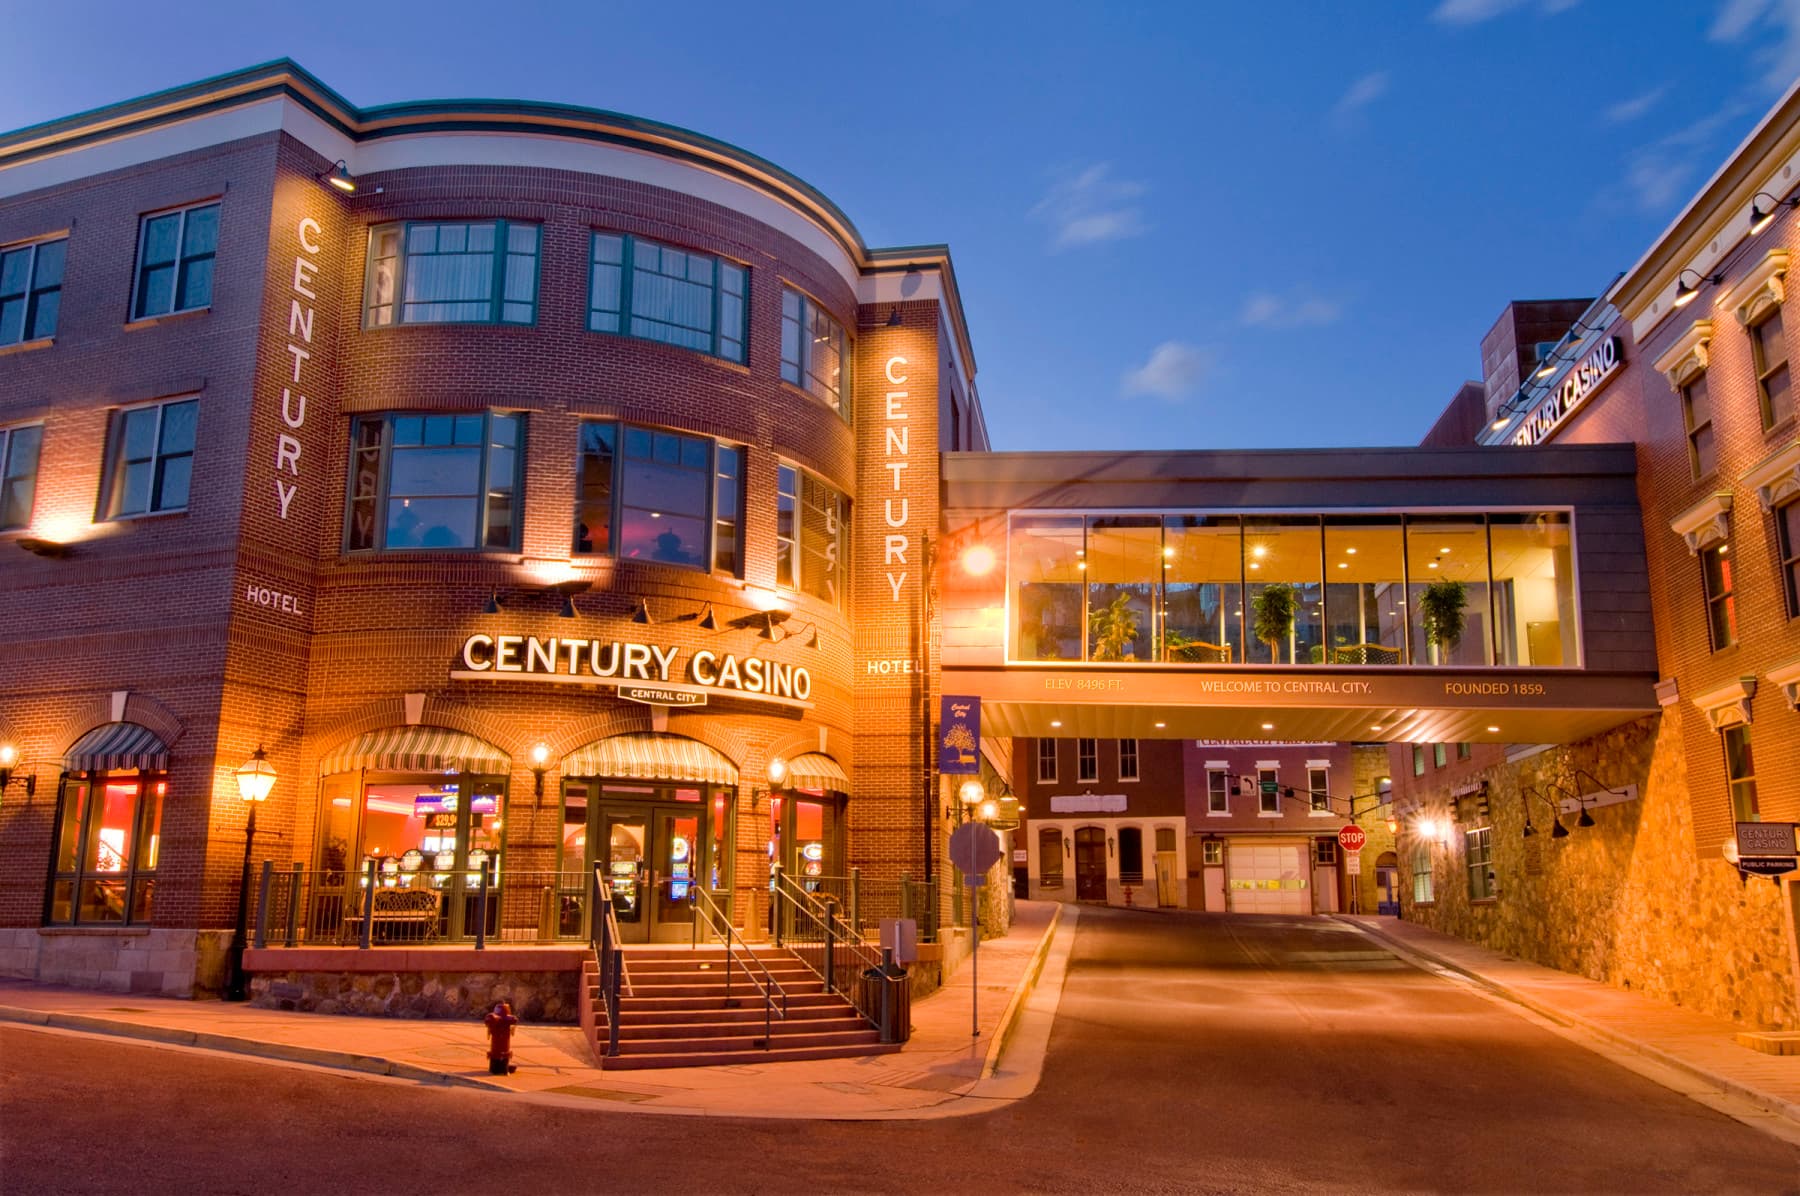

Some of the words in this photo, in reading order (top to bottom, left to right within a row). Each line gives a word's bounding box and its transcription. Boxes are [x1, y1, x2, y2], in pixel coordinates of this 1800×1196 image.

[274, 217, 323, 521] CENTURY
[1563, 337, 1615, 409] CASINO
[884, 356, 909, 602] CENTURY
[246, 585, 303, 616] HOTEL
[463, 634, 679, 682] CENTURY
[692, 650, 812, 702] CASINO
[867, 660, 924, 674] HOTEL
[1045, 679, 1073, 690] ELEV
[1077, 679, 1105, 691] 8496
[1201, 680, 1262, 693] WELCOME
[1264, 681, 1281, 693] TO
[1283, 681, 1339, 694] CENTRAL
[1341, 682, 1373, 695] CITY.
[1445, 682, 1510, 695] FOUNDED
[1513, 683, 1547, 695] 1859.
[631, 689, 674, 700] CENTRAL
[676, 693, 697, 703] CITY
[1340, 832, 1364, 844] STOP
[1741, 830, 1791, 840] CENTURY
[1747, 840, 1788, 849] CASINO
